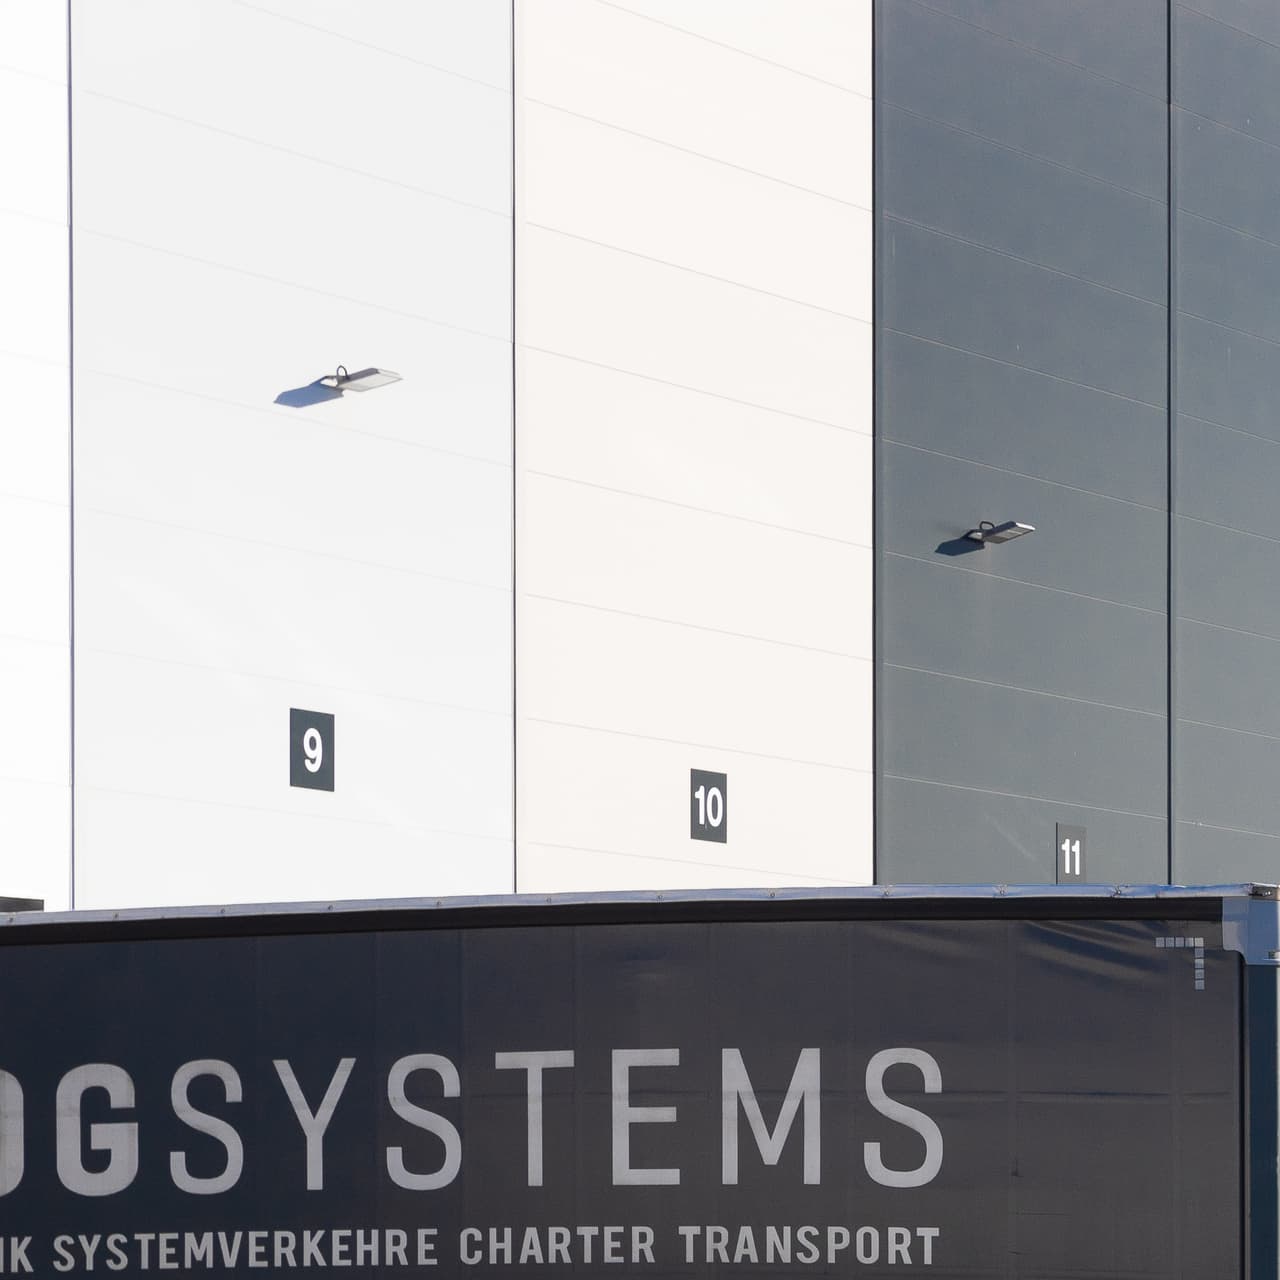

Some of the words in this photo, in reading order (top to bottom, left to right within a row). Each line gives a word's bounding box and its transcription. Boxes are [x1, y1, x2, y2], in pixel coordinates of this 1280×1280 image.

[303, 727, 323, 773] 9
[694, 785, 724, 828] 10
[1061, 838, 1081, 876] 11
[0, 1047, 944, 1198] GSYSTEMS
[52, 1228, 438, 1272] SYSTEMVERKEHRE
[459, 1226, 656, 1265] CHARTER
[678, 1225, 940, 1265] TRANSPORT
